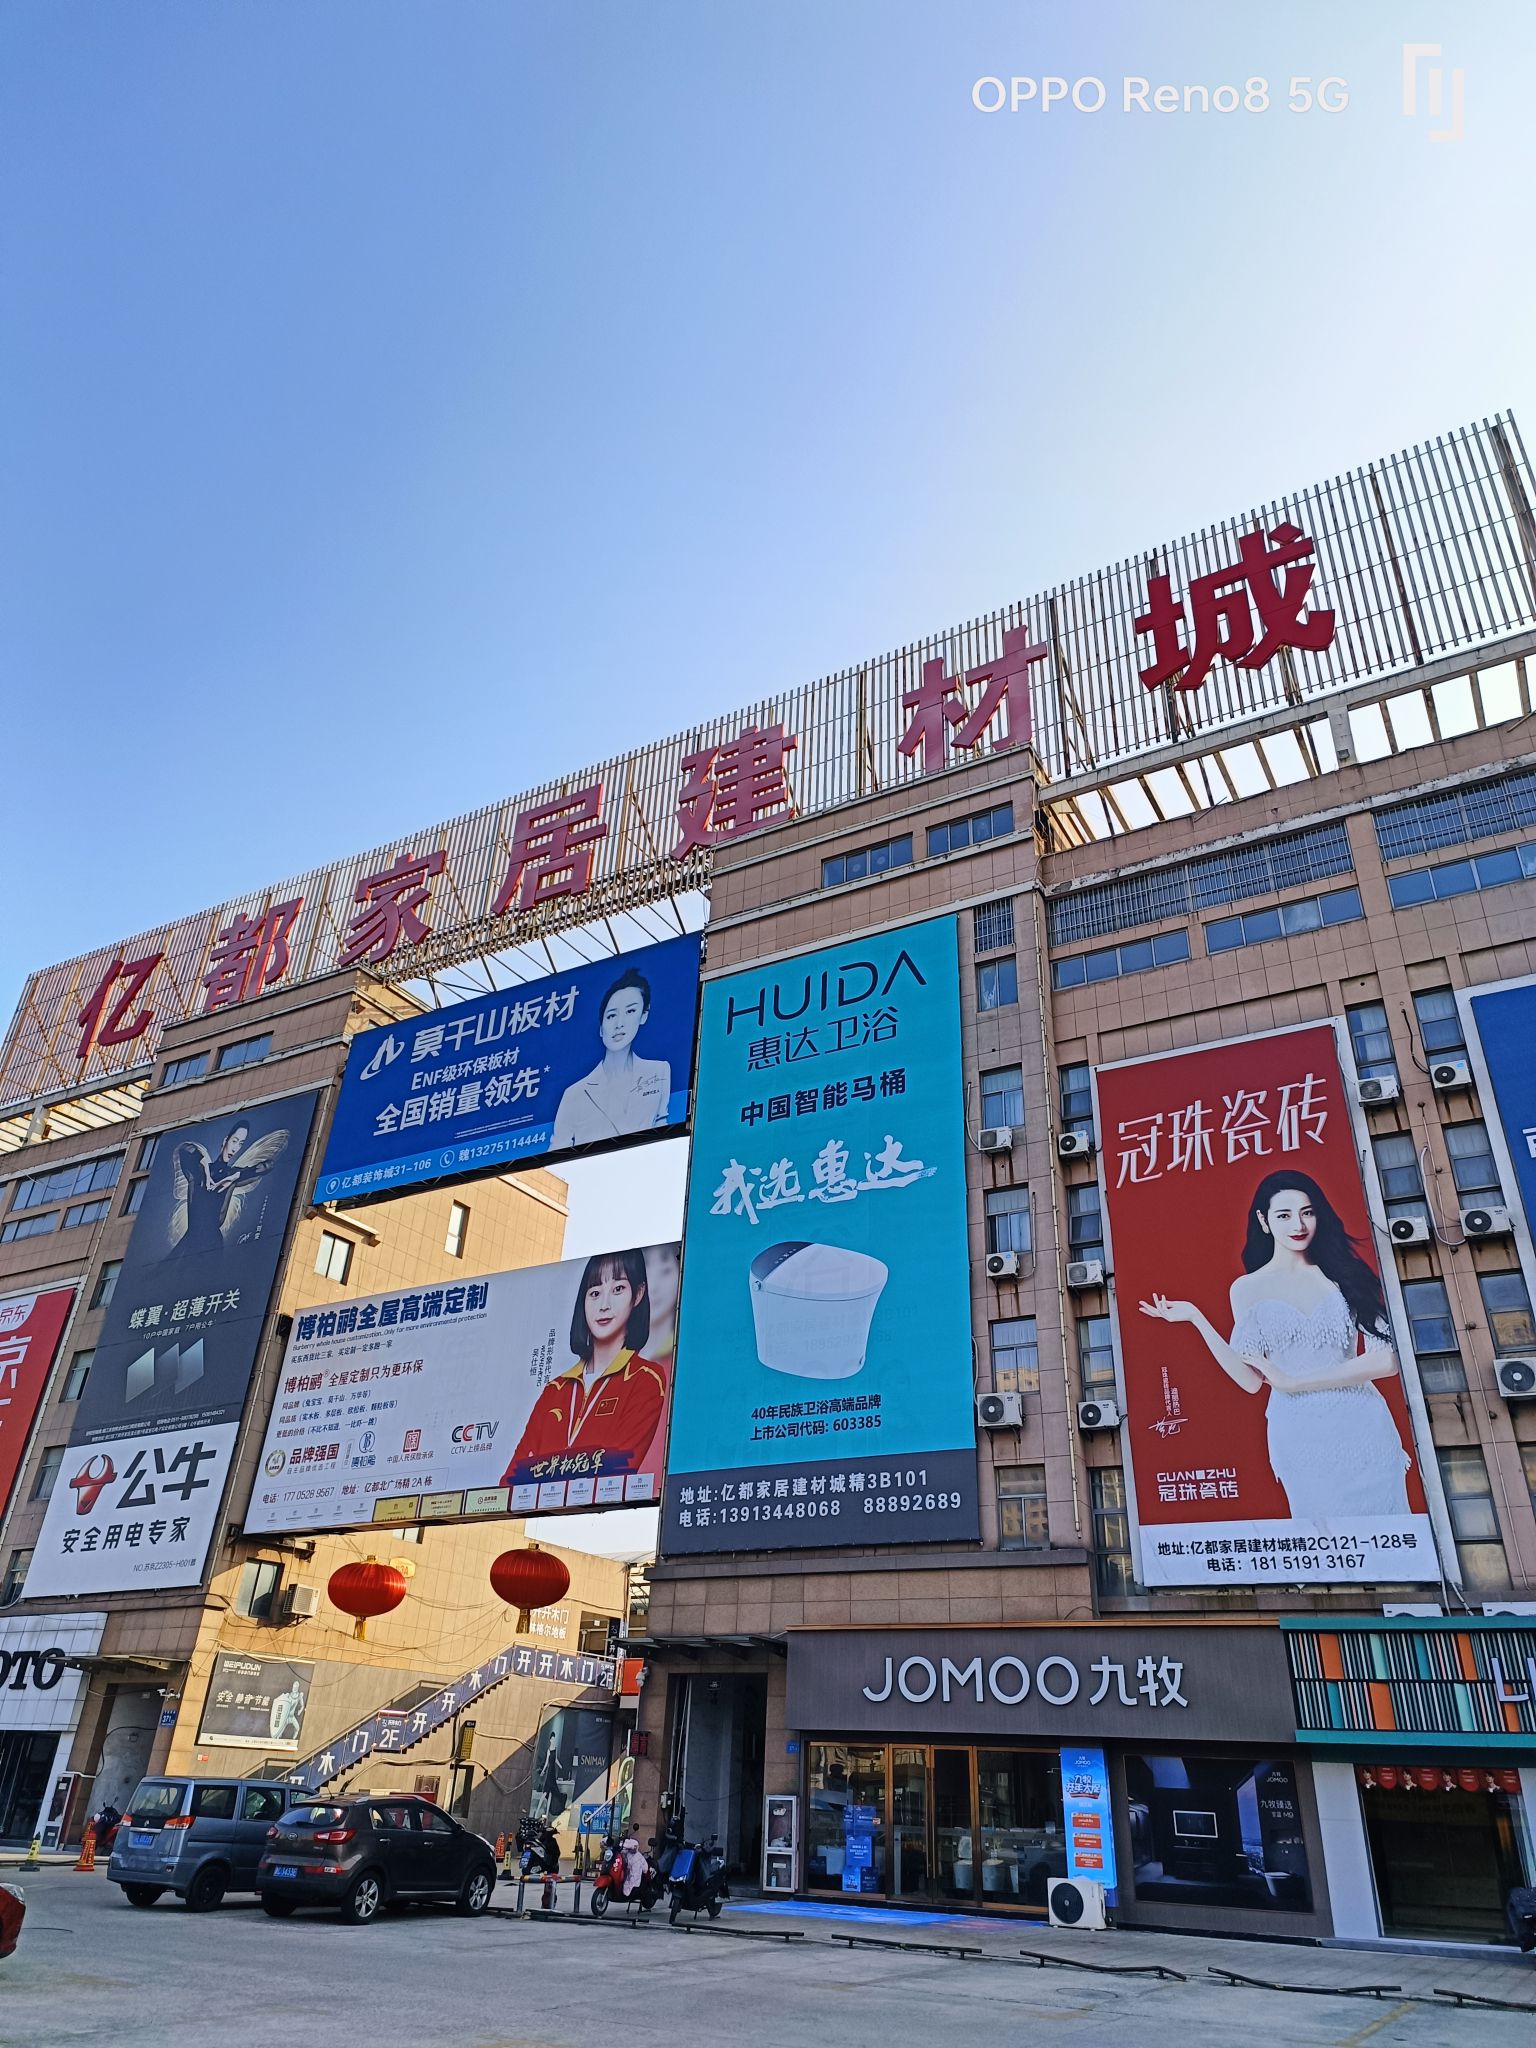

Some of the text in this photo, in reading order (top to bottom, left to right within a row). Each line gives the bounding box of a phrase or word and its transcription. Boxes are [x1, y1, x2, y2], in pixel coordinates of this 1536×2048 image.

[77, 521, 1336, 1059] 亿都家居建材城
[726, 950, 927, 1036] HUIDA
[410, 986, 580, 1063] 莫干山板材
[747, 1005, 899, 1072] 惠达卫浴
[410, 1046, 521, 1091] ENF级环保板材
[740, 1067, 906, 1127] 中国智能马桶
[1115, 1073, 1329, 1189] 冠珠瓷砖
[709, 1134, 938, 1225] 我选惠达
[295, 1282, 489, 1342] 博柏鹂全屋高端定制
[751, 1394, 882, 1421] 40年民族卫浴高端品牌
[833, 1415, 882, 1433] 603385
[451, 1421, 500, 1443] CCTV
[289, 1443, 340, 1465] 品牌强国
[529, 1449, 606, 1478] 世界杯冠军
[116, 1442, 217, 1510] 公牛
[1158, 1480, 1240, 1501] 冠珠瓷砖
[863, 1492, 961, 1514] 88892689
[62, 1517, 191, 1554] 安全用电专家
[1250, 1557, 1277, 1571] 181
[1284, 1555, 1322, 1570] 5191
[1327, 1553, 1365, 1569] 3167
[516, 1650, 594, 1682] 开开木门
[379, 1728, 400, 1748] 2F
[580, 1755, 606, 1766] SNIMAY
